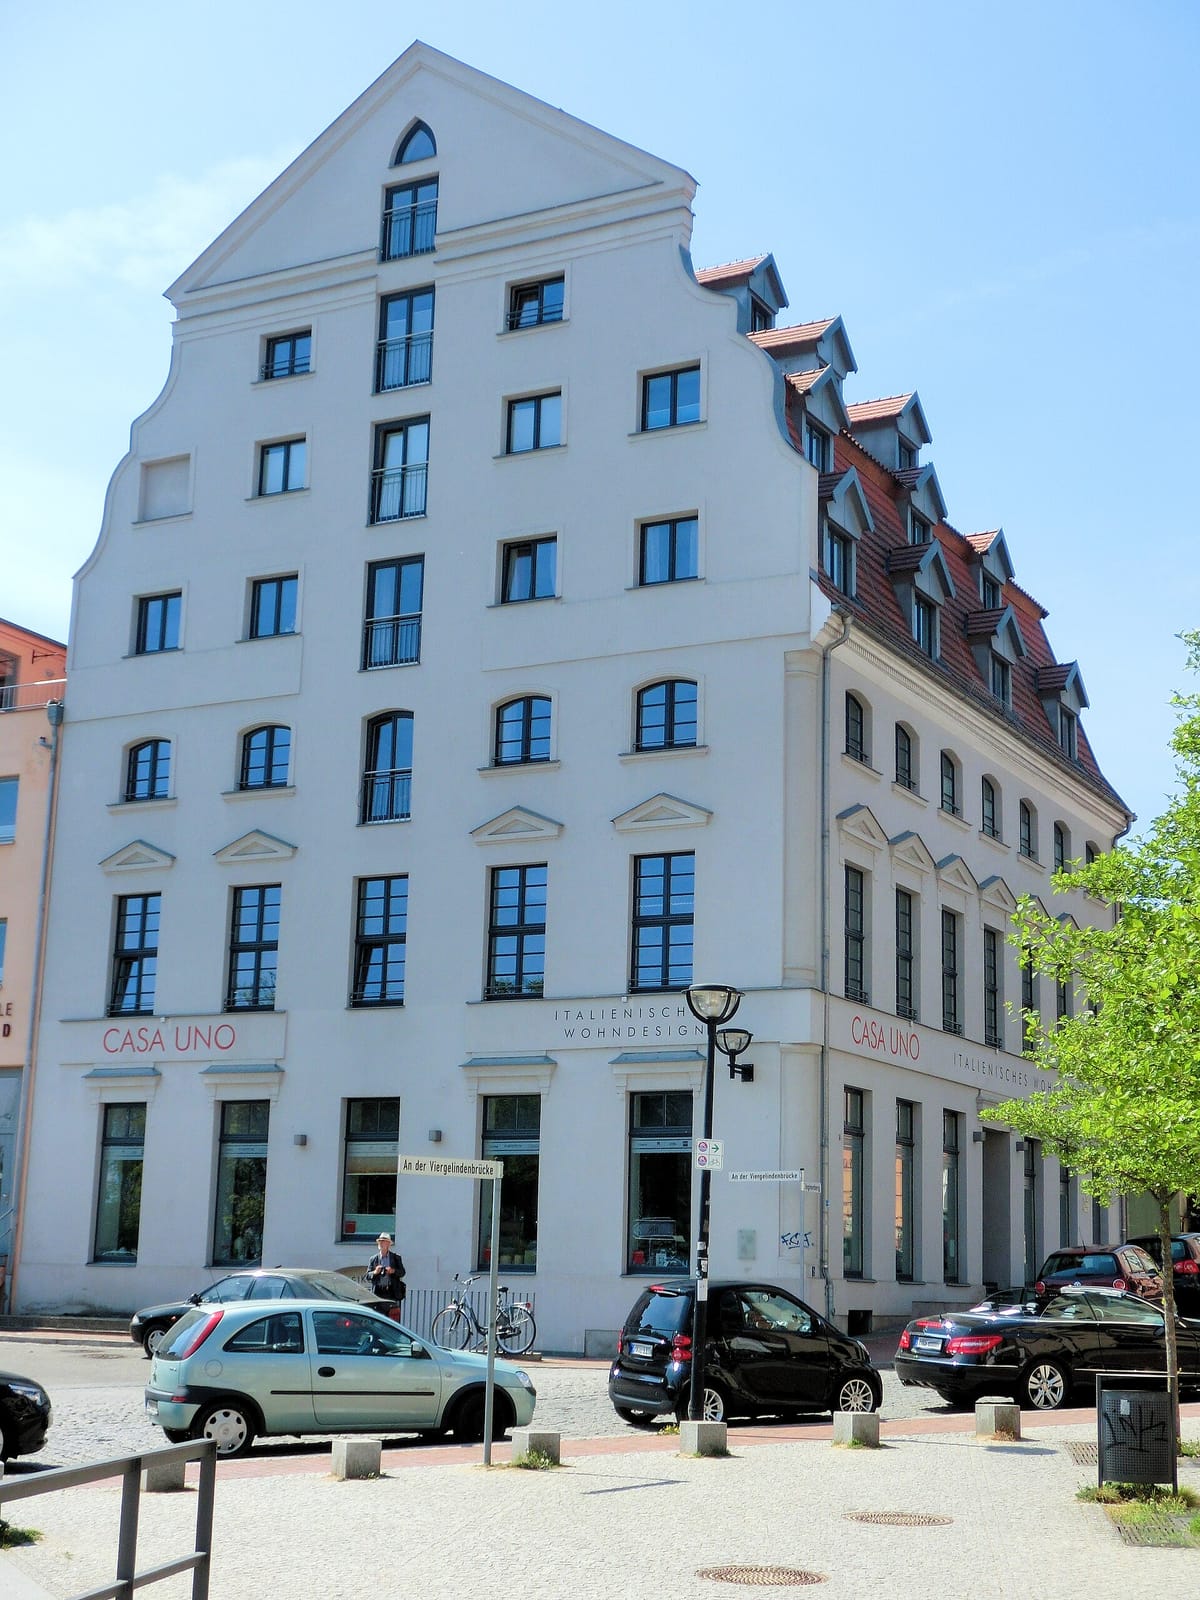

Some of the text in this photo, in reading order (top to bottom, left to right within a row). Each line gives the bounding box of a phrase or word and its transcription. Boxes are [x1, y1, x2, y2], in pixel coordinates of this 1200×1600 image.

[555, 1007, 685, 1021] ITALIENISCH
[103, 1024, 235, 1053] CASA UNO
[564, 1025, 704, 1039] WOHNDESIGN
[851, 1016, 920, 1060] CASA UNO
[953, 1052, 1028, 1087] ITALIENISCHES
[403, 1159, 494, 1176] An der Viergelindenbrücke
